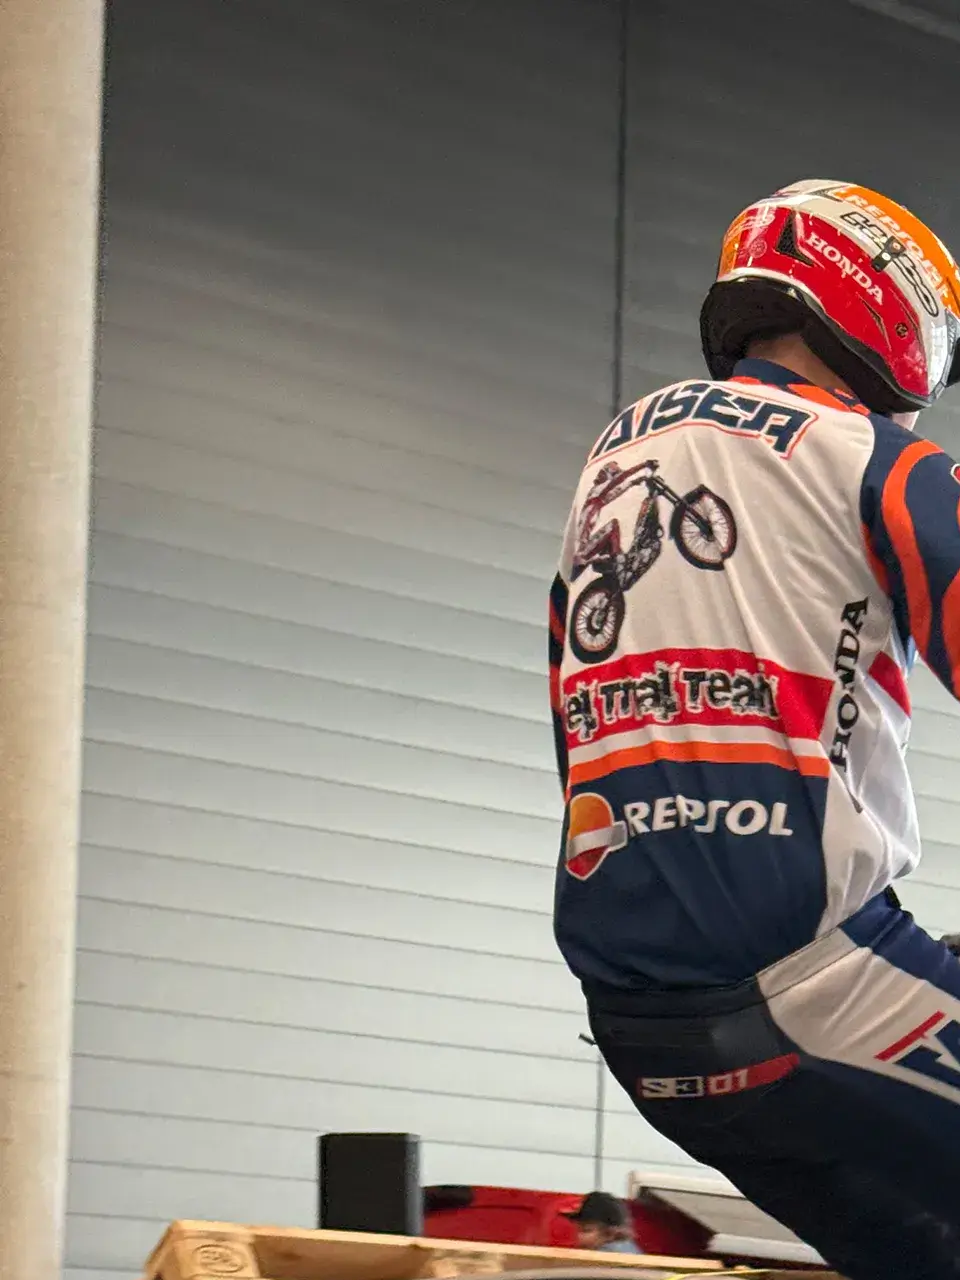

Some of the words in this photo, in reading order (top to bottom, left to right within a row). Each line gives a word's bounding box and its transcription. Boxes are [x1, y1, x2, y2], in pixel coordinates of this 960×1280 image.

[805, 231, 883, 306] HONDA
[829, 597, 869, 772] HONDA
[626, 795, 794, 837] REPSOL
